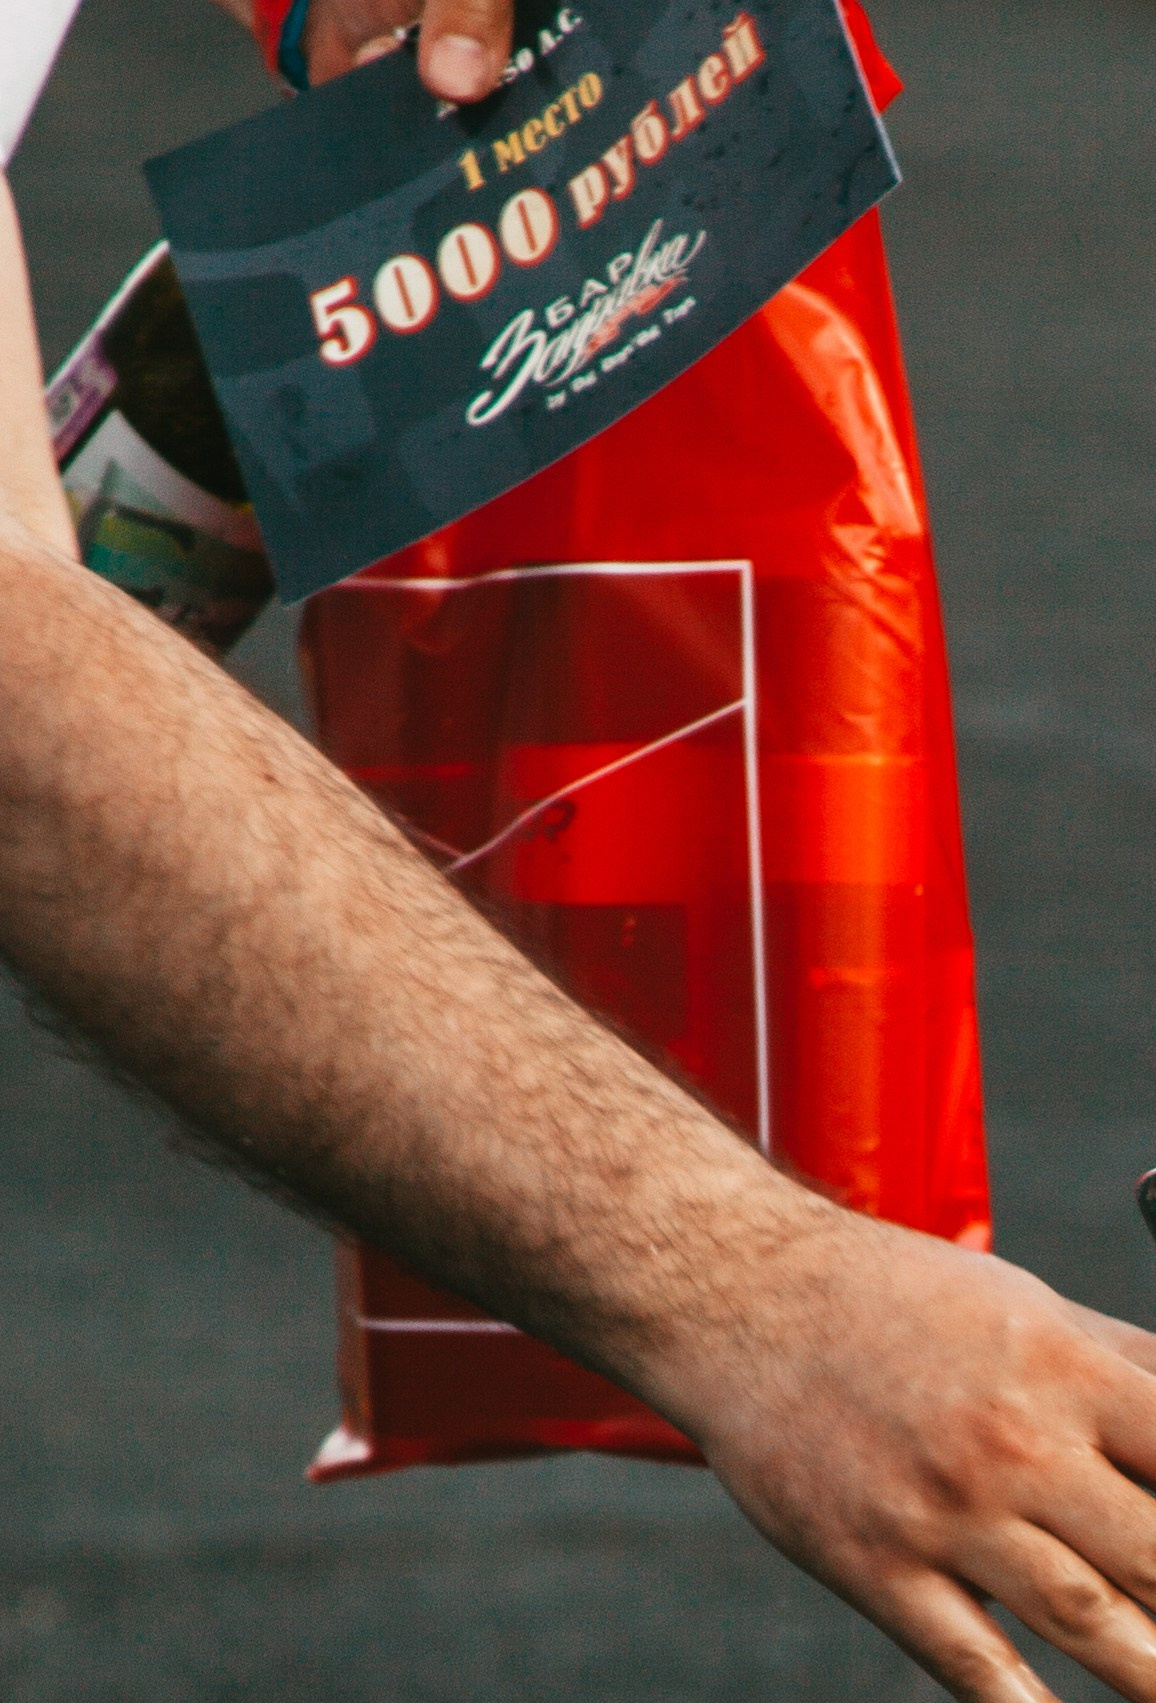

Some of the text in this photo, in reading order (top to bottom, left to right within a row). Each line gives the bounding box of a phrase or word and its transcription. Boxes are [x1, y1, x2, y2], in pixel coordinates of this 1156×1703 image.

[308, 186, 560, 368] 5000
[567, 11, 767, 230] рублей
[457, 147, 487, 193] 1
[491, 70, 604, 174] место
[544, 252, 634, 329] БАР
